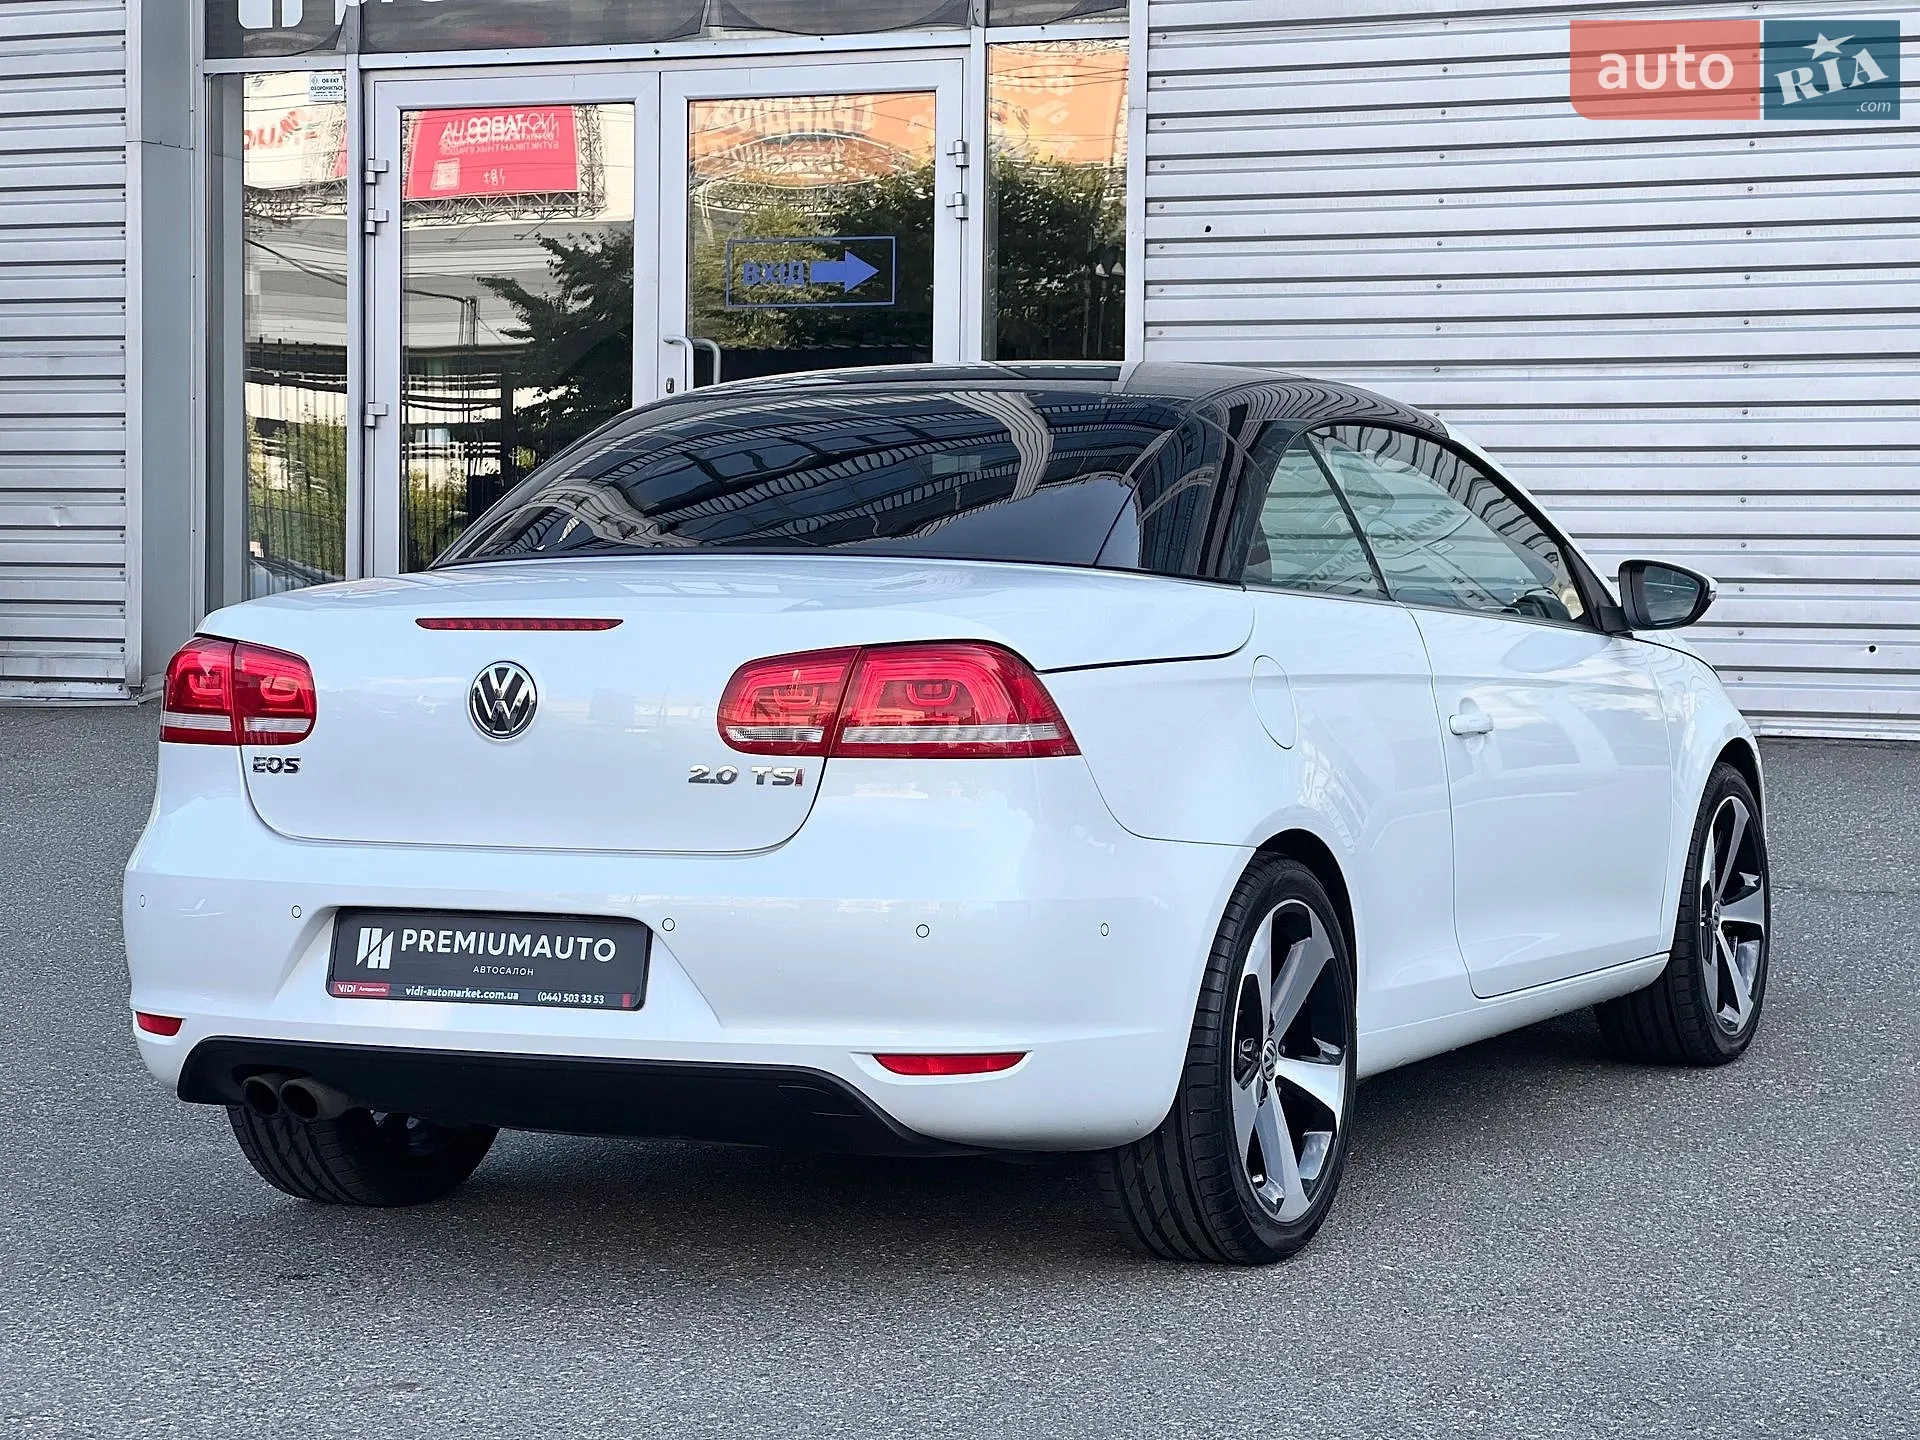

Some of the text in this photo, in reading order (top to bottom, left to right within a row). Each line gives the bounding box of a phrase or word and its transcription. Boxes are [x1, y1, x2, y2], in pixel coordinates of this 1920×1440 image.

[253, 756, 301, 774] EOS
[688, 764, 804, 786] 2.0 TSI
[401, 929, 616, 961] PREMIUMAUTO
[473, 965, 534, 977] АВТОСАЛОН
[338, 984, 357, 993] VIDI
[406, 986, 605, 1004] vidi-automarket.com.ua (044) 503 33 53
